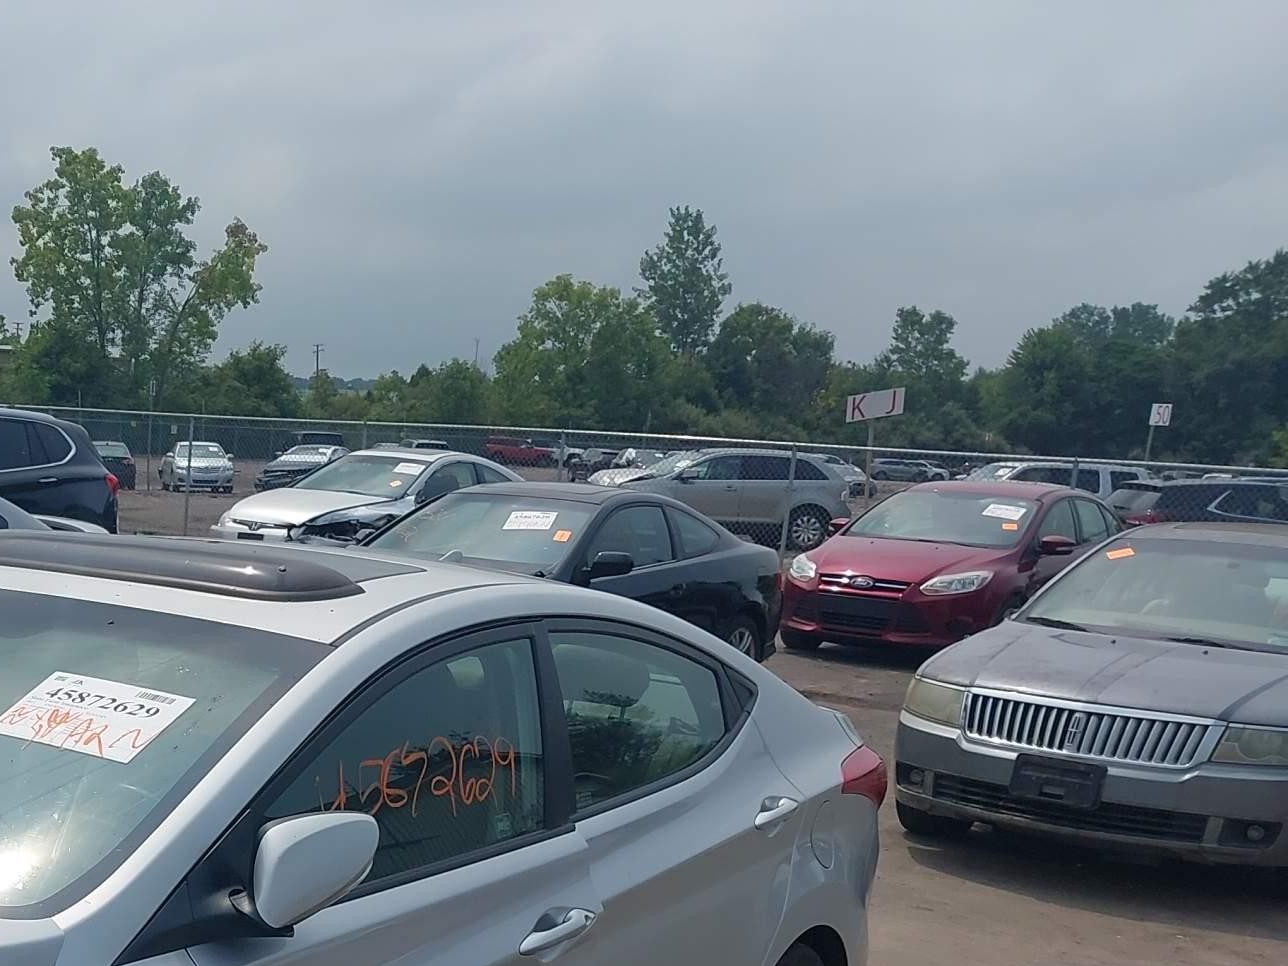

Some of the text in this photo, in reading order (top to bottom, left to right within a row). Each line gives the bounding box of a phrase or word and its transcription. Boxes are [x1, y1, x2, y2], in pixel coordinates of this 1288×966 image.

[850, 390, 898, 420] K J
[1154, 404, 1170, 425] 50
[45, 686, 161, 719] 45872629
